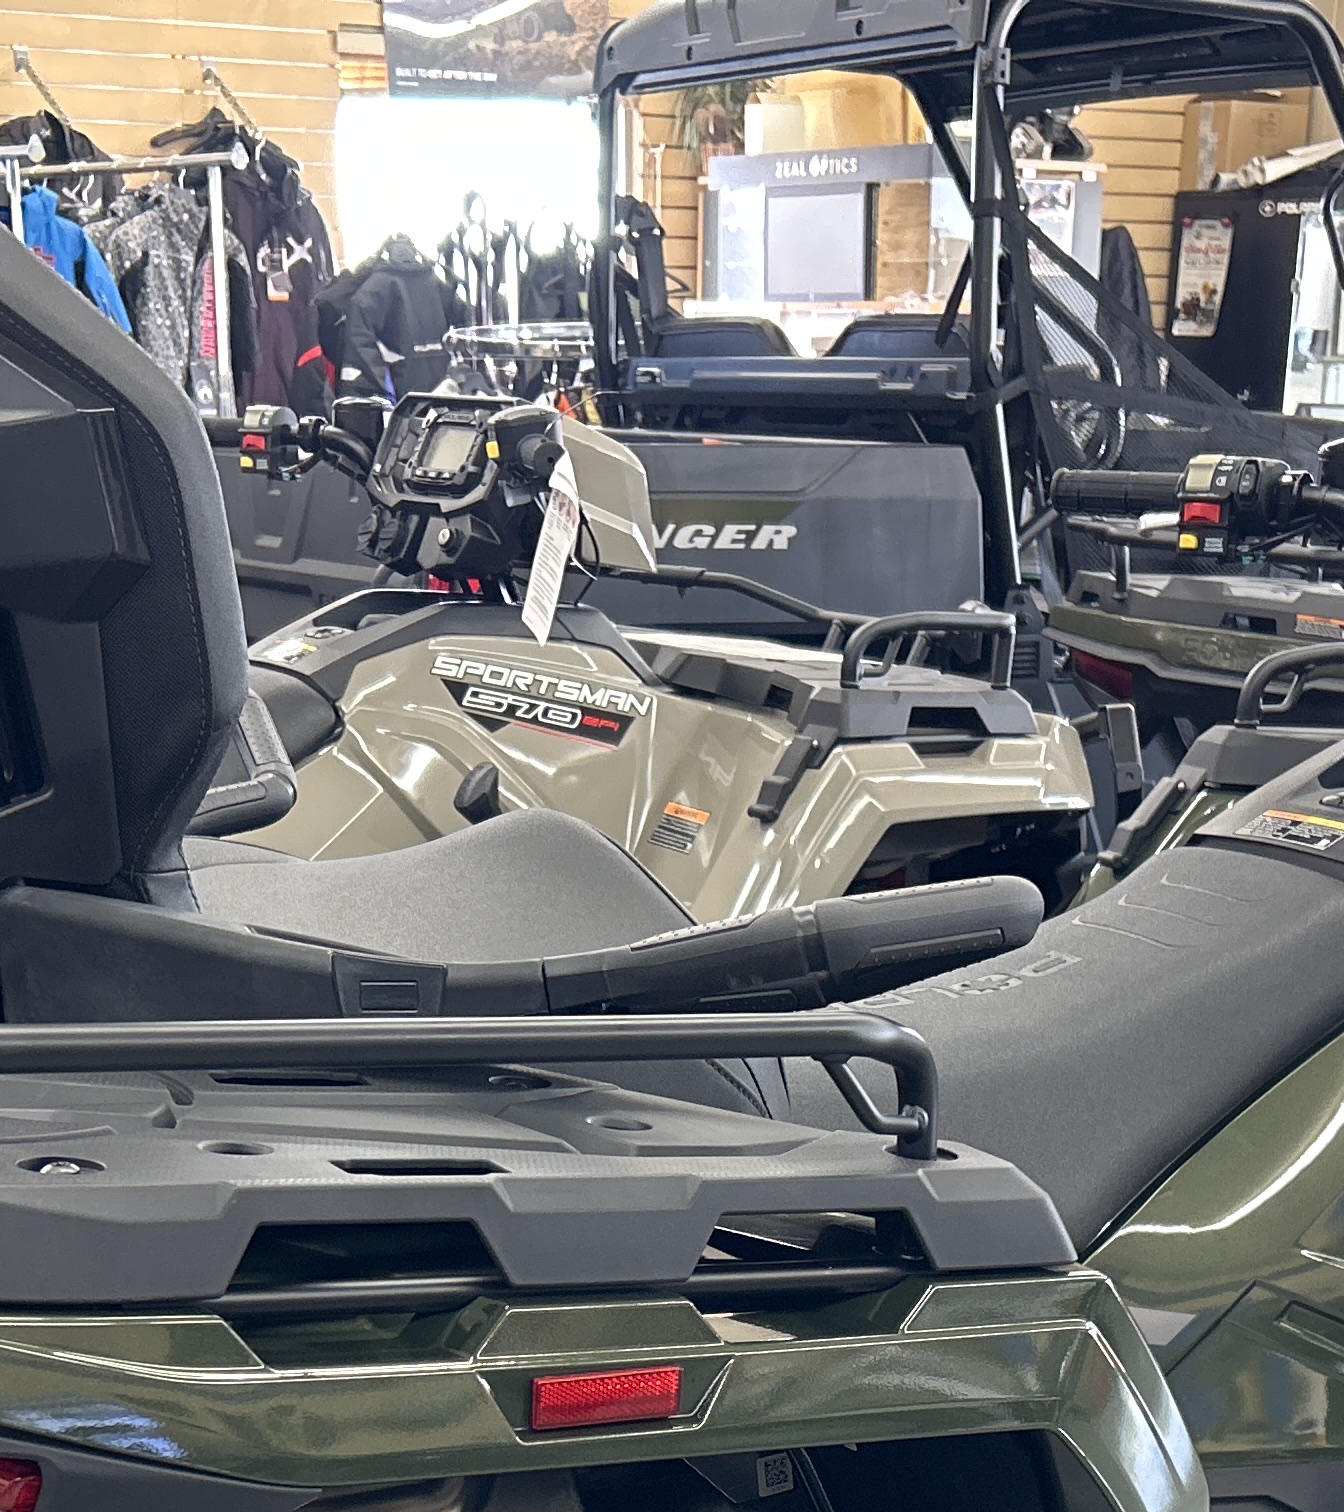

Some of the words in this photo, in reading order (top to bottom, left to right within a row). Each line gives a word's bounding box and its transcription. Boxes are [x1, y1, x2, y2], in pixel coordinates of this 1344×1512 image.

[651, 523, 798, 550] NGER
[430, 656, 654, 716] SPORTSMAN
[461, 686, 583, 729] 570
[582, 715, 620, 731] EFI
